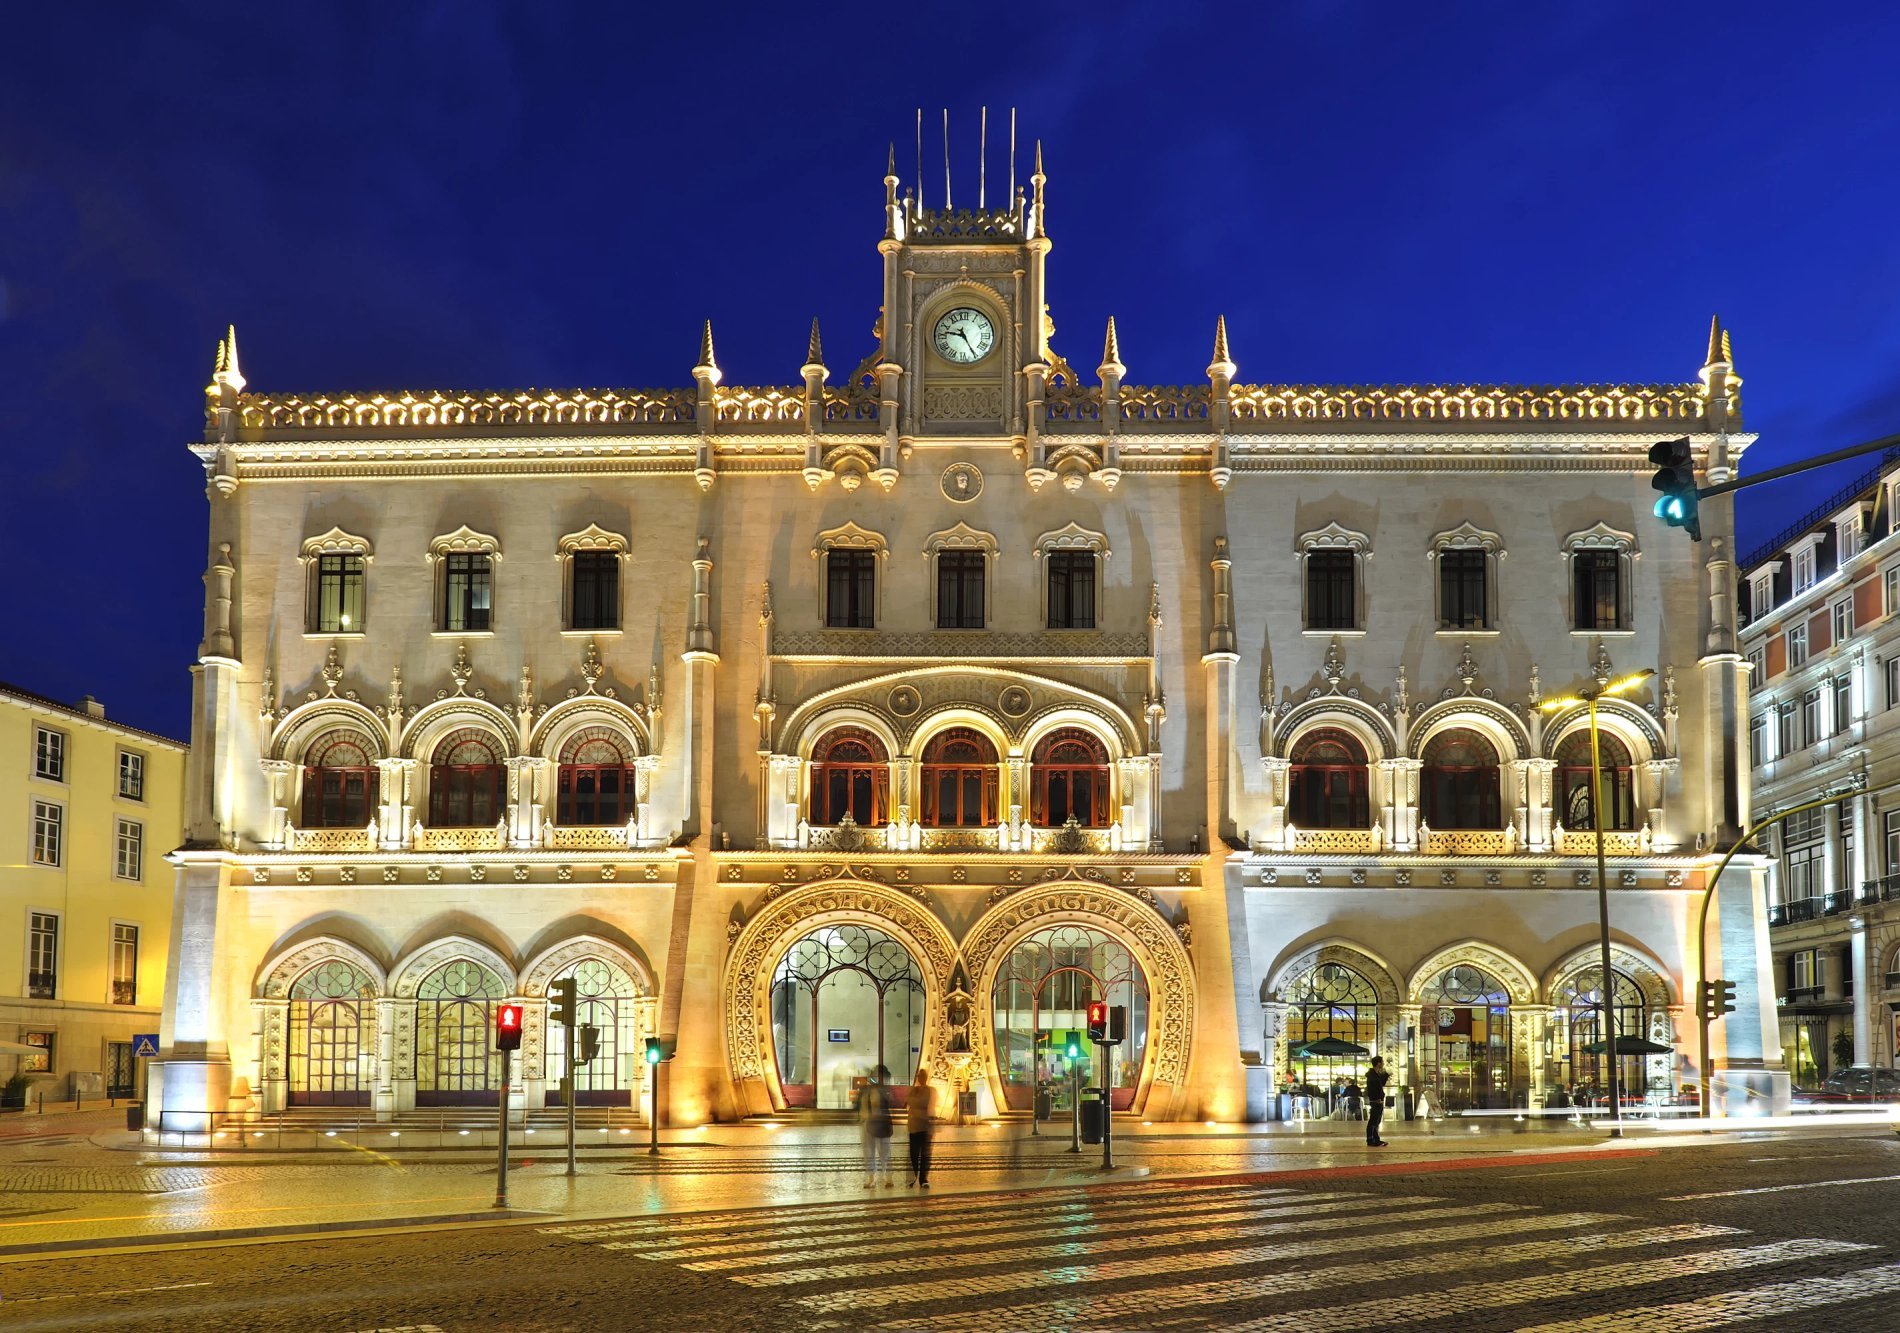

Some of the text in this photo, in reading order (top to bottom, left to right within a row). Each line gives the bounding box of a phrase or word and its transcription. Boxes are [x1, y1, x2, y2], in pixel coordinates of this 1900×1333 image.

[949, 314, 959, 324] XI
[959, 312, 969, 320] XII
[972, 314, 978, 322] I
[941, 322, 951, 330] X
[959, 352, 967, 361] VI
